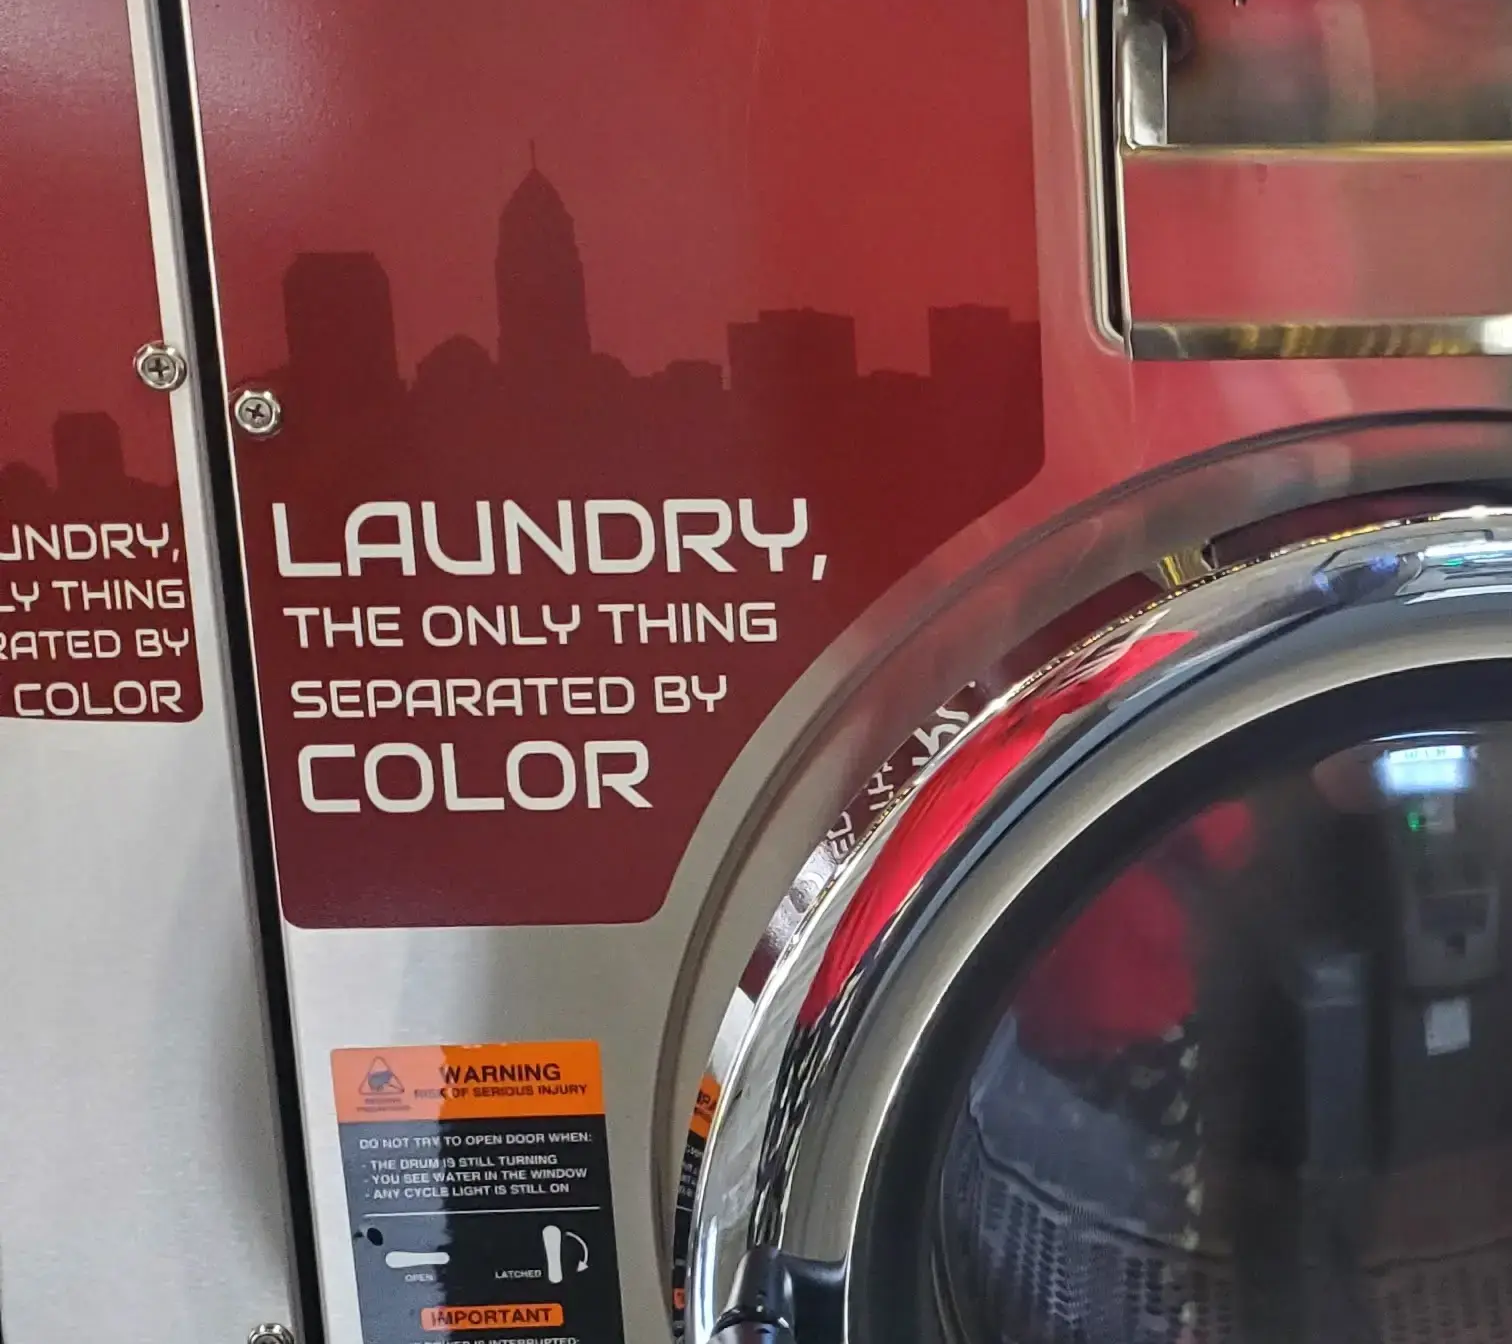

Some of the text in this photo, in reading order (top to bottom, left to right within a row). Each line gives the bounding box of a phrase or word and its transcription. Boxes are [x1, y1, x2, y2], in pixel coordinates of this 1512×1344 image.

[272, 498, 827, 580] LAUNDRY,
[51, 579, 185, 611] THING
[283, 602, 778, 649] THE ONLY THING
[135, 628, 189, 657] BY
[14, 680, 184, 716] COLOR
[291, 675, 728, 719] SEPARATED BY
[298, 740, 654, 813] COLOR
[440, 1063, 562, 1084] WARNING
[452, 1087, 468, 1097] OF
[474, 1086, 534, 1097] SERIOUS
[538, 1084, 587, 1095] INJURY
[359, 1132, 592, 1150] DO NOT TRY TO OPEN DOOR WHEN:
[370, 1155, 558, 1171] THE DRUM IS STILL TURNING
[372, 1168, 588, 1185] YOU SEE WATER IN THE WINDOW
[373, 1183, 570, 1200] ANY CYCLE LIGHT IS STILL ON
[405, 1273, 434, 1283] OPEN
[495, 1270, 542, 1280] LATCHED
[431, 1308, 552, 1326] IMPORTANT
